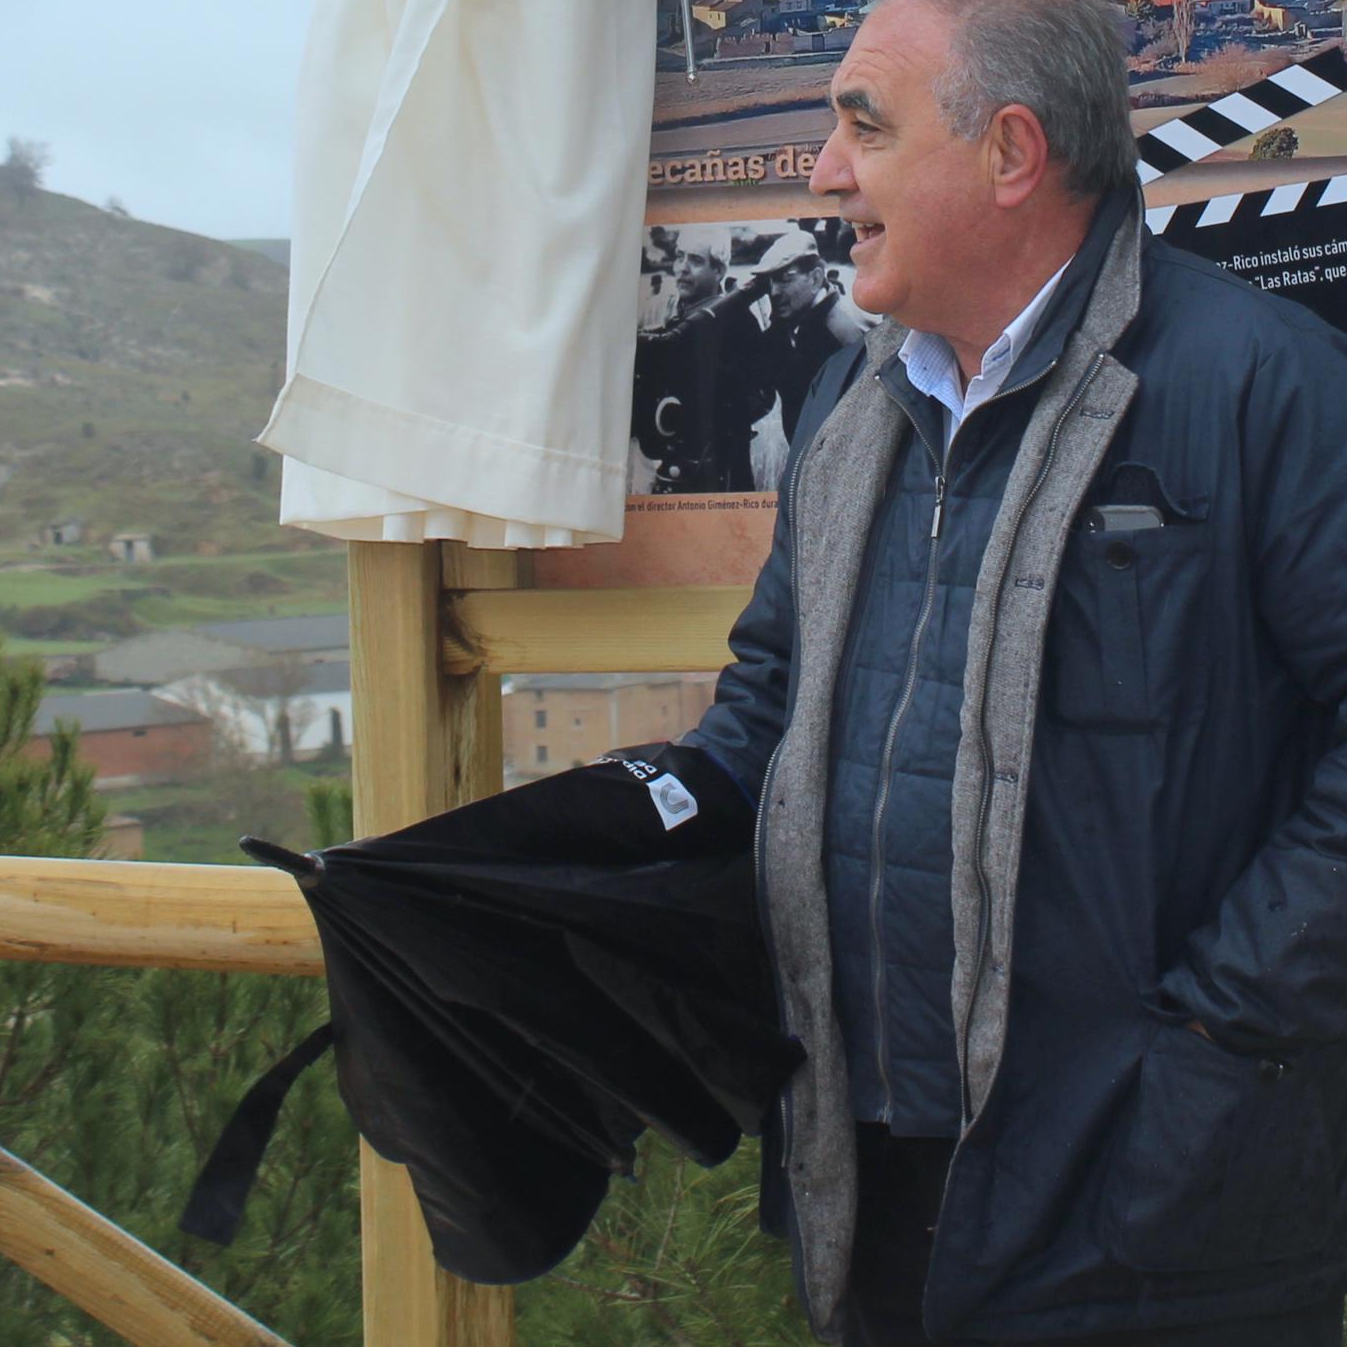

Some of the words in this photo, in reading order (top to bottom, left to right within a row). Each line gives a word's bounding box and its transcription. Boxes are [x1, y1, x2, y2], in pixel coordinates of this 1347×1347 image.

[648, 149, 766, 185] ecañas
[1259, 245, 1301, 266] instaló
[1302, 244, 1323, 260] sus
[1325, 263, 1347, 281] que
[677, 499, 706, 511] Antonio
